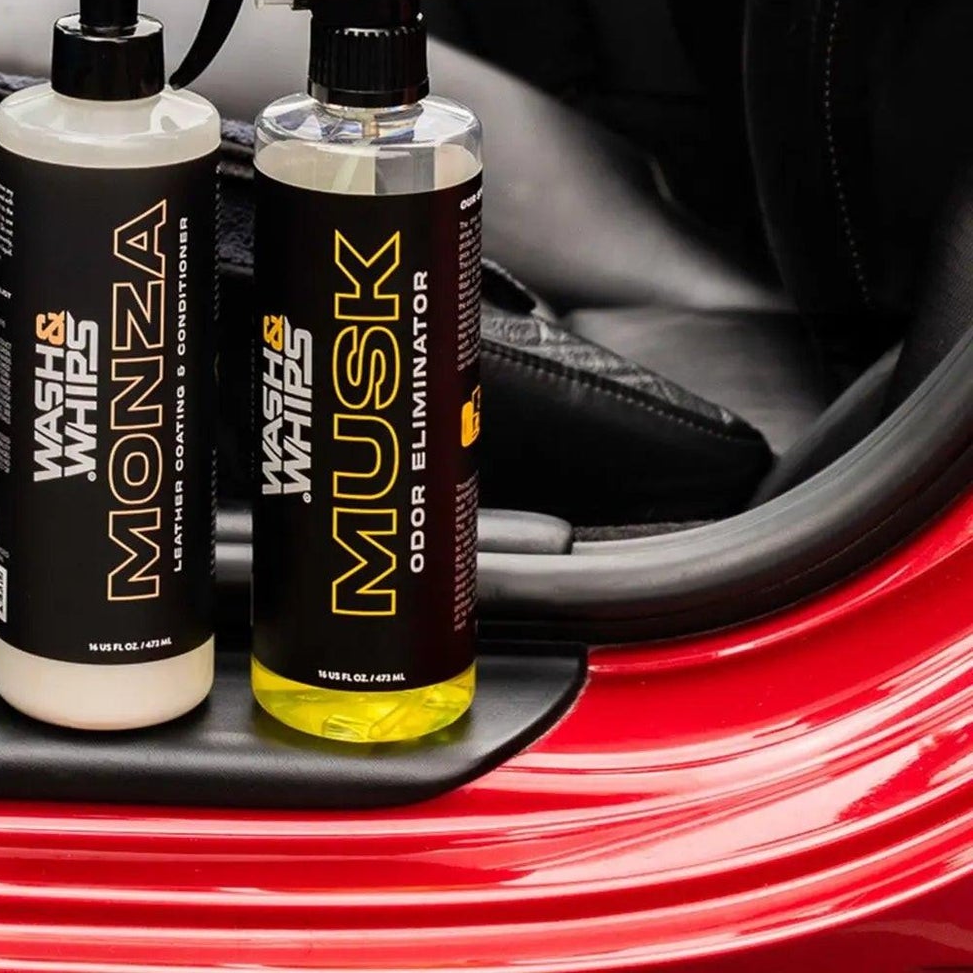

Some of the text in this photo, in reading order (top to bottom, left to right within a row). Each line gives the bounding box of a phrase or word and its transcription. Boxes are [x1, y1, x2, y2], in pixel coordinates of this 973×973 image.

[177, 216, 188, 356] CONDITIONER
[64, 310, 99, 478] WHIPS
[107, 198, 167, 601] MONZA
[175, 385, 186, 472] COATING
[283, 315, 313, 495] WHIPS
[331, 228, 401, 616] MUSK
[410, 270, 428, 573] ODOR ELIMINATOR
[173, 480, 184, 573] LEATHER
[89, 637, 172, 652] 16 US FL OZ. / 473 ML
[318, 669, 405, 683] 16 US FL OZ. / 473 ML
